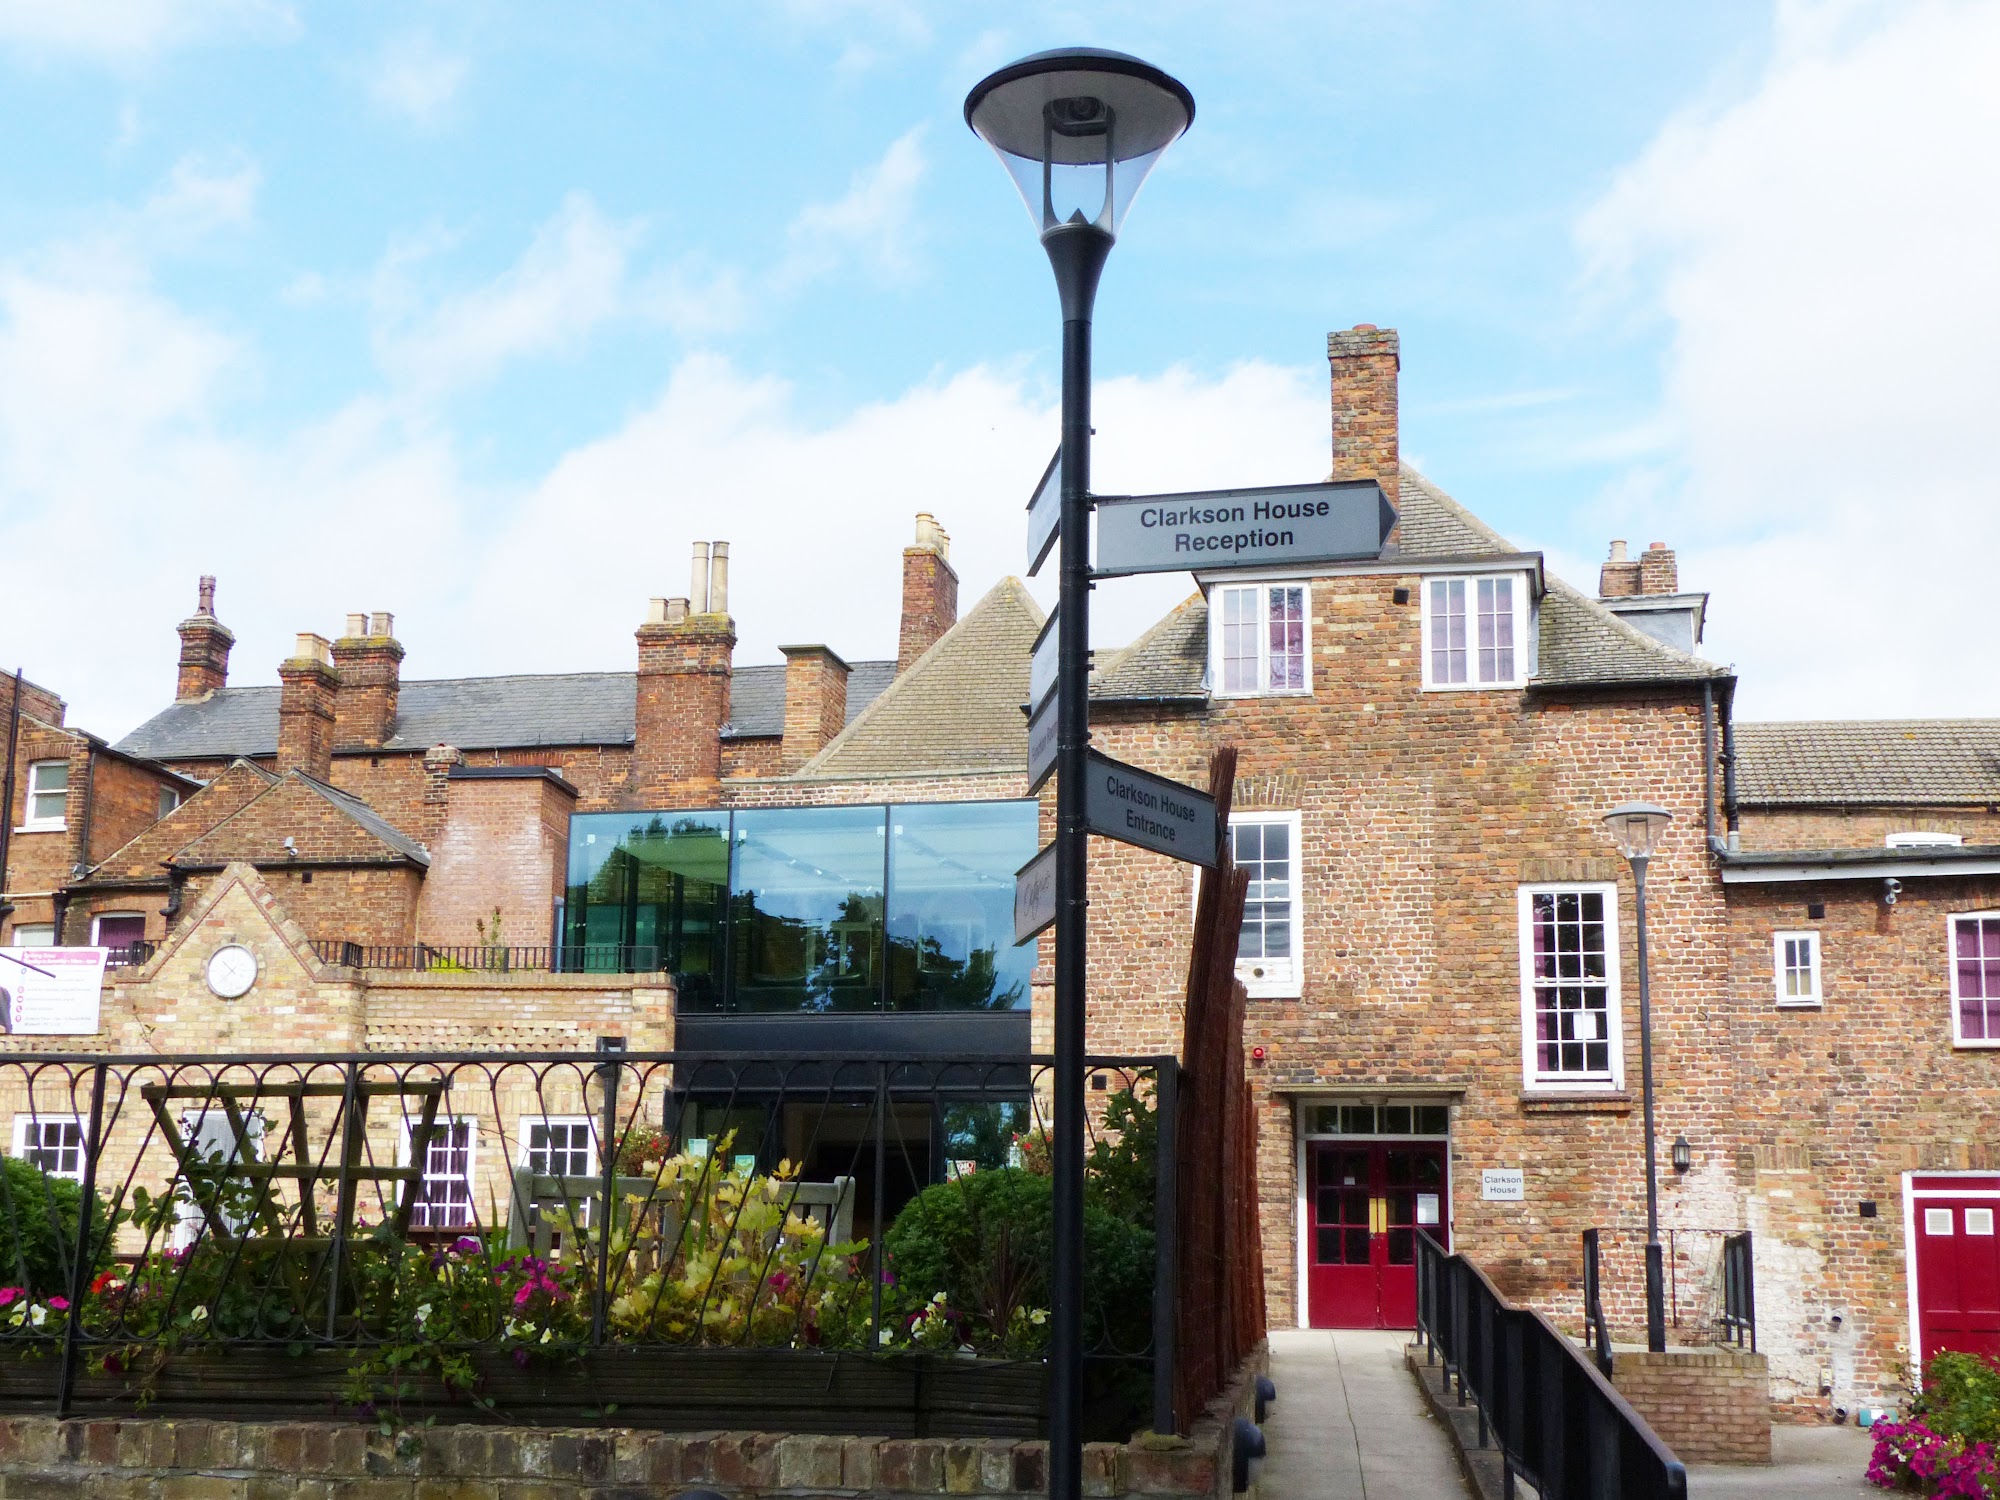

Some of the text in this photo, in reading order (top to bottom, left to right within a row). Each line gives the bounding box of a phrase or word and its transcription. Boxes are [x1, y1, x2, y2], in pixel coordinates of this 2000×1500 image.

[1140, 500, 1331, 529] Clarkson House
[1175, 528, 1294, 553] Reception
[1106, 775, 1196, 823] Clarkson House
[1126, 808, 1176, 841] Entrance
[1484, 1176, 1522, 1194] Clarkson House
